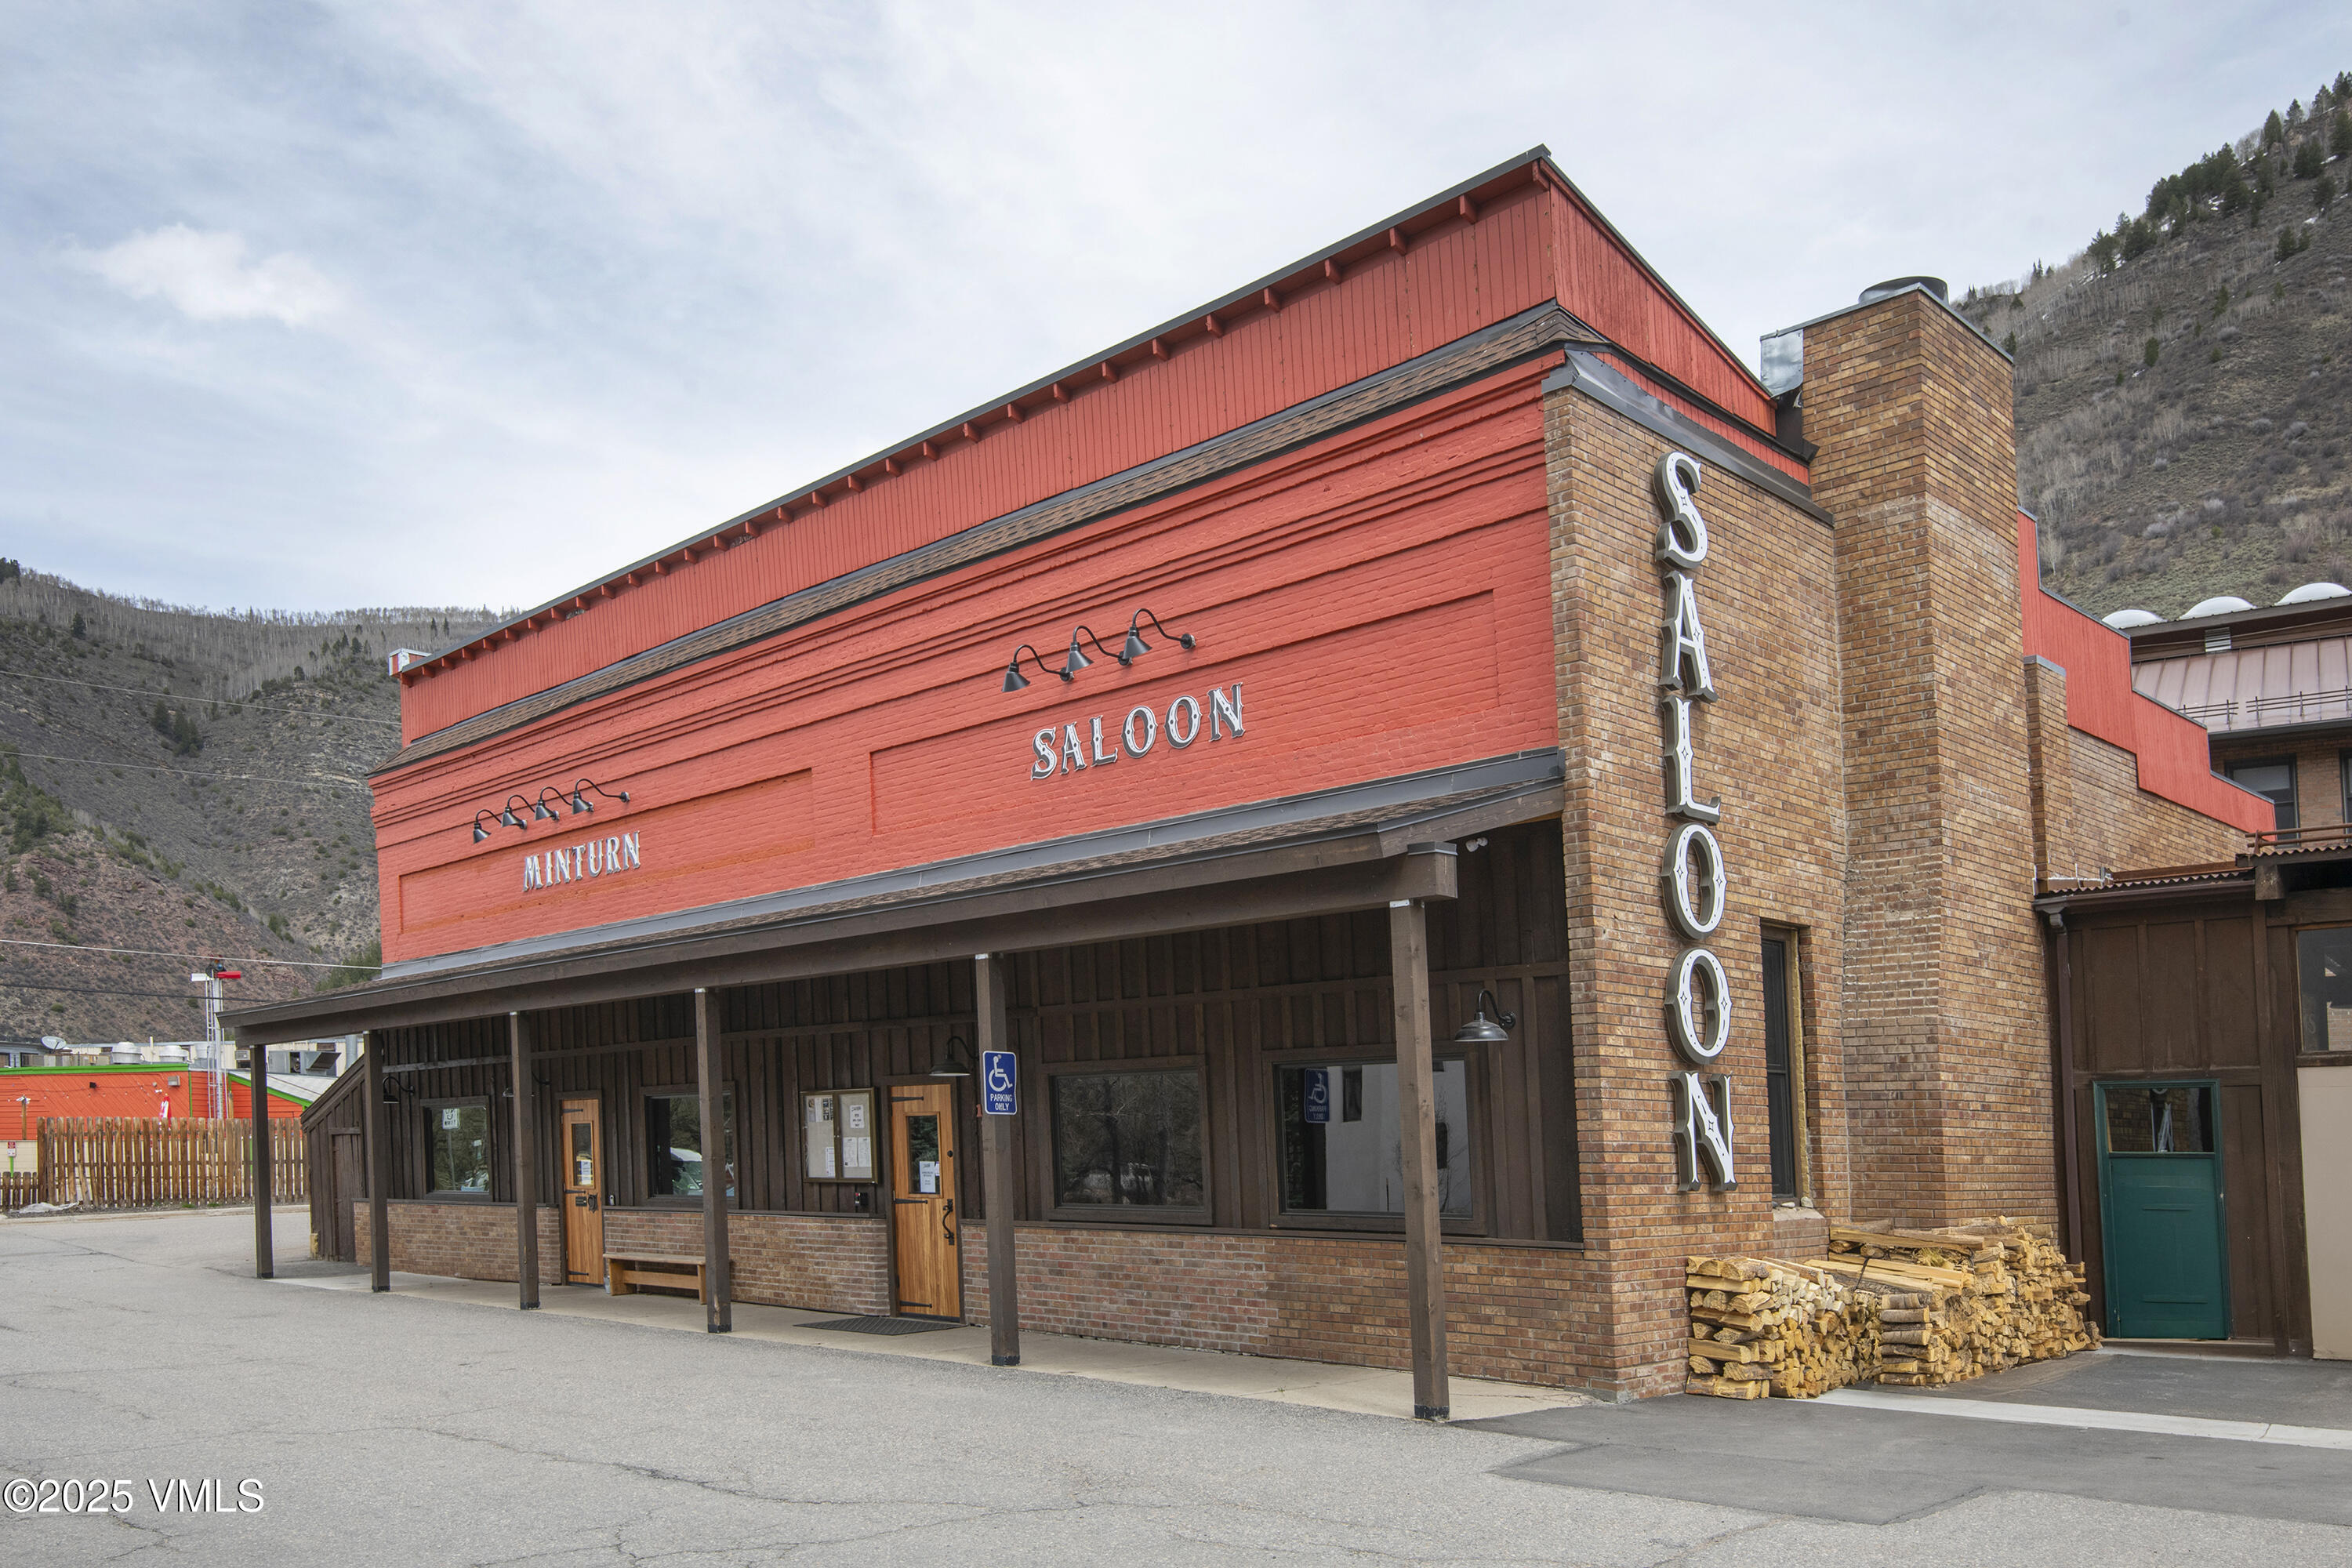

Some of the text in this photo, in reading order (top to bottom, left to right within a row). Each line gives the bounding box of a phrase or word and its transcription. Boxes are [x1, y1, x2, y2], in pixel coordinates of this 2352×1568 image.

[1030, 682, 1246, 781] SALOON
[523, 830, 640, 892] MINTURN
[1653, 452, 1738, 1191] SALOON
